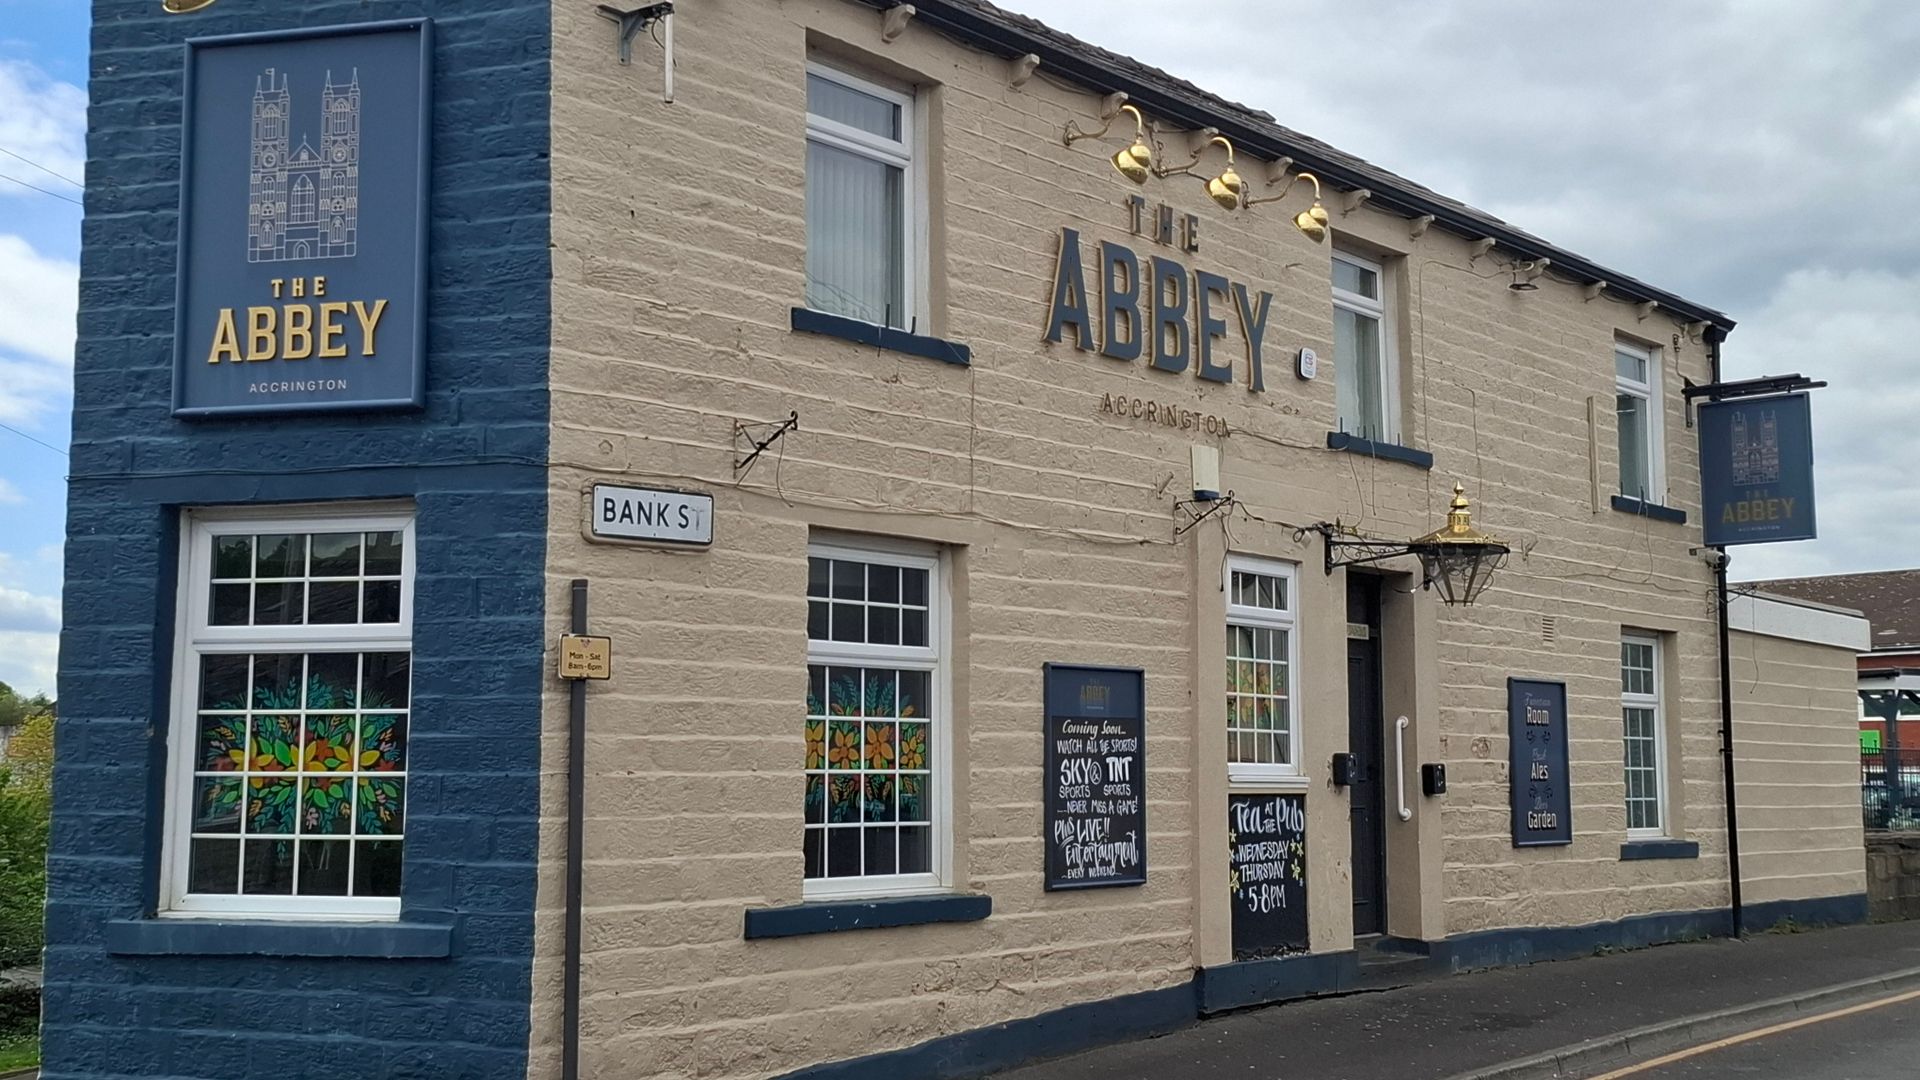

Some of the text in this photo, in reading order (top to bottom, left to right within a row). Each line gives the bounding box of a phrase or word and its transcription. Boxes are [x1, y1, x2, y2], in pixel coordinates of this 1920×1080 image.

[1127, 194, 1199, 253] THE
[271, 276, 326, 298] THE
[1041, 227, 1273, 393] ABBEY
[207, 299, 388, 364] ABBEY
[249, 379, 348, 393] ACCRINGTON
[1102, 392, 1230, 438] ACCRINGTON
[602, 497, 670, 528] BANK
[1722, 497, 1795, 524] ABBEY
[569, 651, 584, 660] Mon
[590, 652, 601, 661] Sat
[1526, 706, 1549, 725] Room
[1062, 719, 1099, 740] Coming
[1057, 738, 1083, 754] WATCH
[1086, 739, 1098, 754] ALL
[1060, 757, 1092, 785] SKY
[1105, 756, 1133, 782] TNT
[1531, 762, 1549, 780] Ales
[1059, 783, 1132, 799] SPORTS SPORTS
[1091, 799, 1108, 814] MISS
[1108, 800, 1115, 815] A
[1230, 797, 1304, 835] Tea AT THE Pub
[1527, 811, 1557, 829] Garden
[1238, 840, 1289, 862] WEDNESDAY
[1240, 860, 1285, 883] THURSDAY
[1248, 883, 1286, 913] 5-8PM
